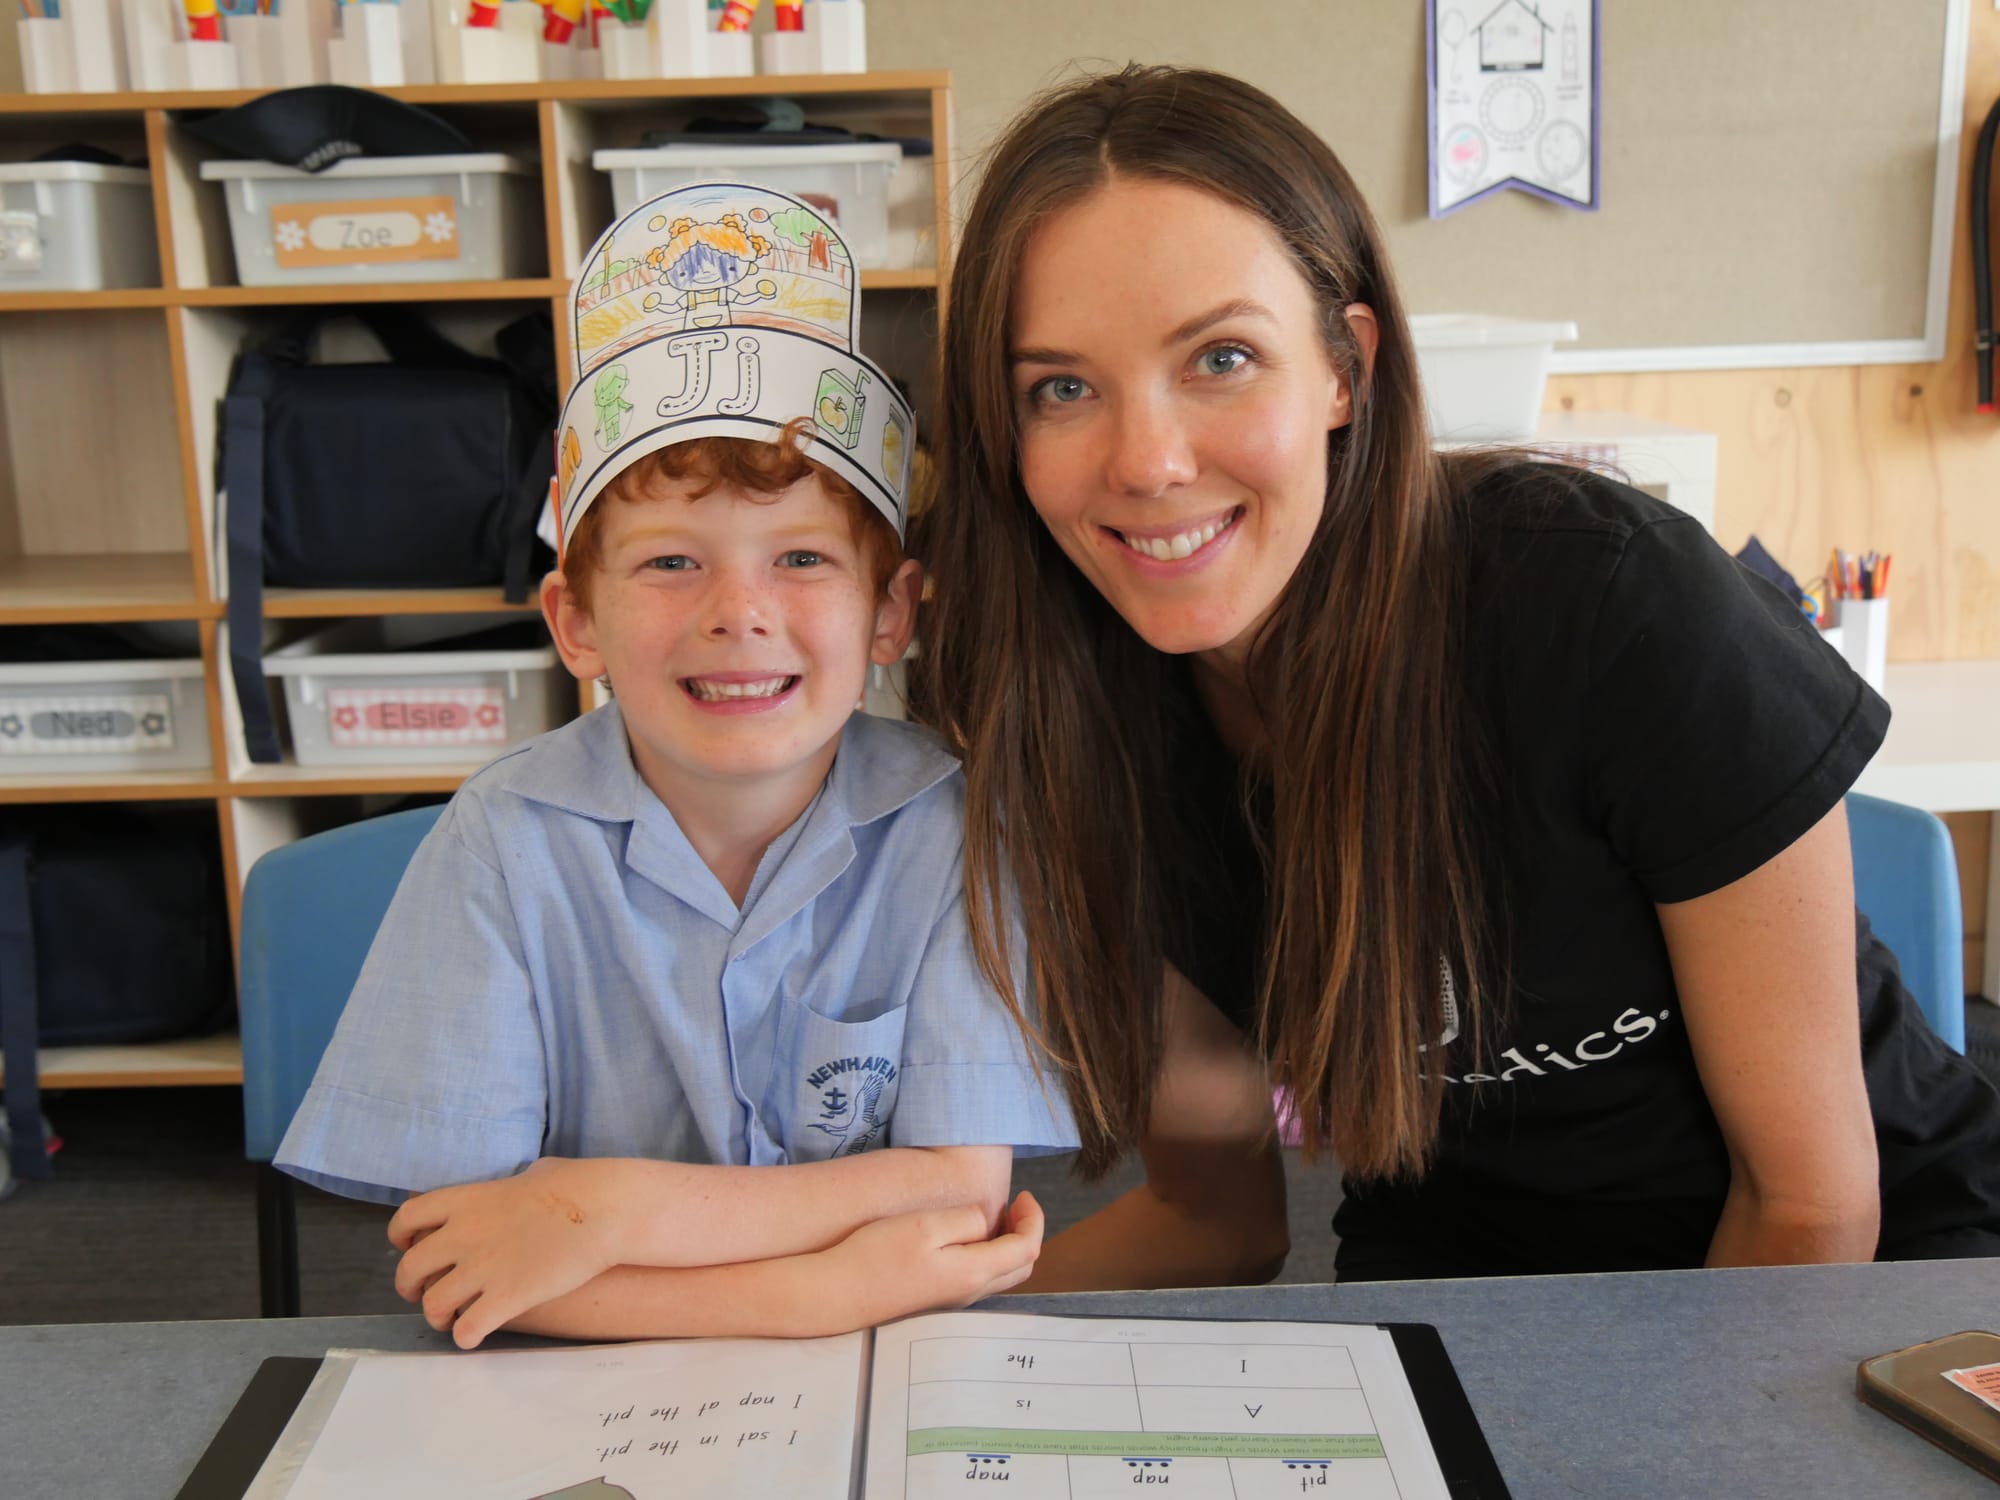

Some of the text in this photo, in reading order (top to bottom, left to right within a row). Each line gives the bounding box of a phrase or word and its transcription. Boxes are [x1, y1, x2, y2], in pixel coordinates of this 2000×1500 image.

[338, 219, 393, 248] Zoe
[50, 710, 114, 738] Ned
[380, 702, 457, 730] Elsie
[806, 1056, 897, 1090] NEWHAVEN
[1007, 1354, 1035, 1369] the
[599, 1391, 803, 1428] I nap at the pit.
[1016, 1399, 1031, 1410] is
[1243, 1403, 1263, 1419] A
[596, 1429, 798, 1463] I sat in the pit.
[965, 1463, 1010, 1481] map
[1132, 1467, 1169, 1485] nap
[1300, 1469, 1327, 1493] pit
